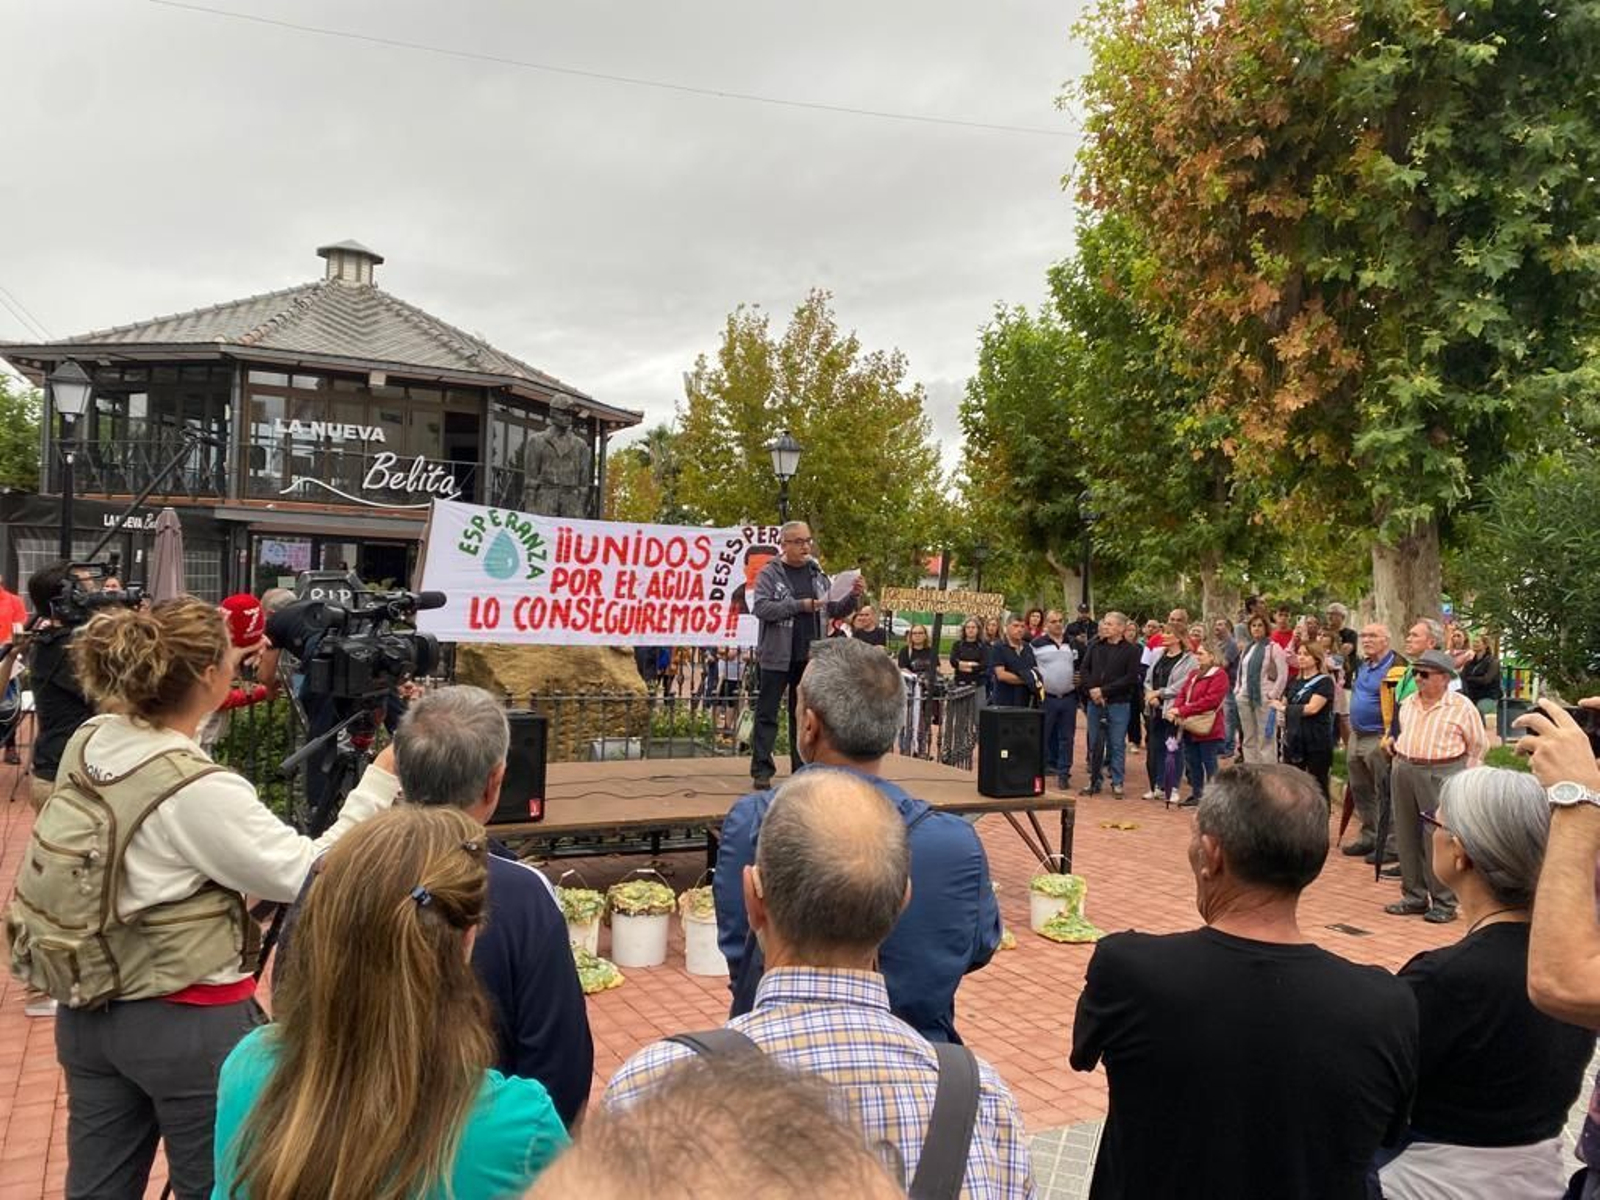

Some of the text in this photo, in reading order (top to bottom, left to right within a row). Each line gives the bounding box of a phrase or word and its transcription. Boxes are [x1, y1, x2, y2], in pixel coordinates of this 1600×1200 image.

[275, 418, 386, 442] LA NUEVA
[362, 452, 456, 495] Belita
[458, 509, 548, 580] ESPERANZA
[709, 525, 782, 601] DESESPER
[550, 567, 705, 601] POR EL AGUA
[243, 606, 261, 632] 7
[469, 597, 500, 630] LO
